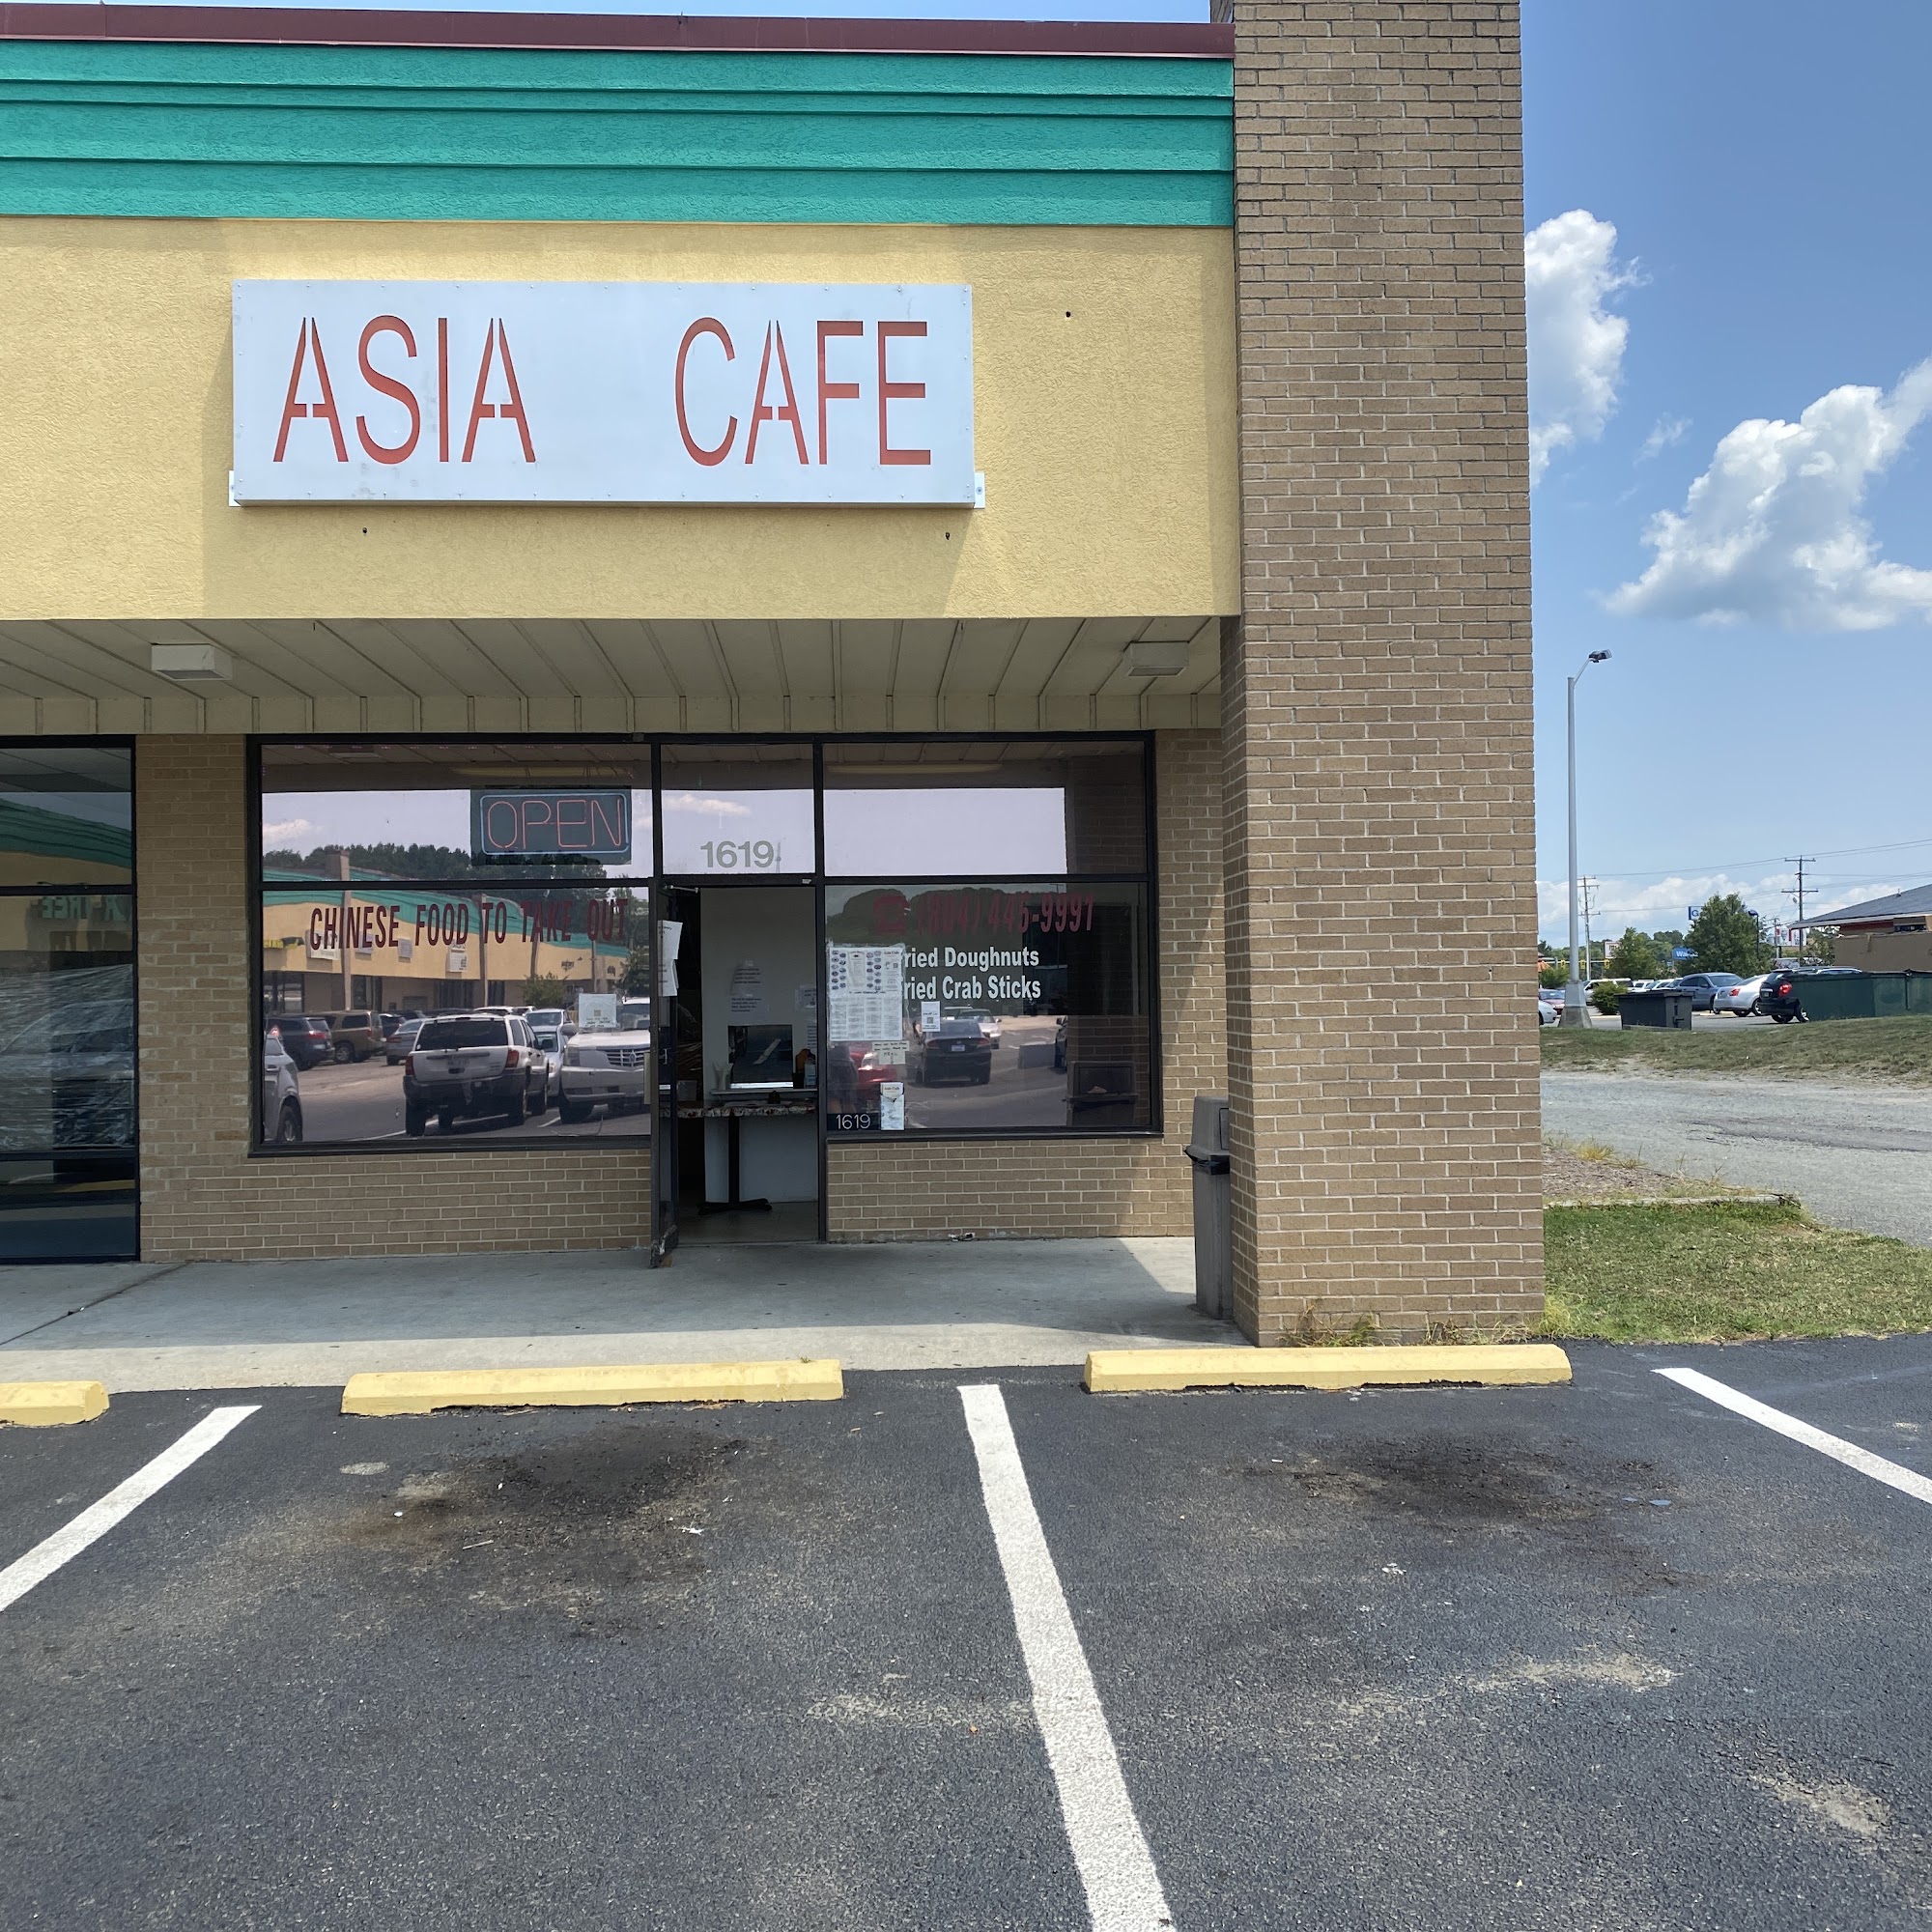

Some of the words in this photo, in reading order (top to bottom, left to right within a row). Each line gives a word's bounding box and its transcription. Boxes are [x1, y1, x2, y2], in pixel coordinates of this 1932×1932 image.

[272, 315, 536, 464] ASIA
[675, 317, 932, 466] CAFE
[487, 799, 622, 849] OPEN
[700, 840, 775, 868] 1619
[309, 904, 401, 951] CHINESE
[414, 902, 469, 947] FOOD
[480, 901, 507, 945] TO
[520, 899, 573, 943] TAKE
[586, 897, 628, 942] OUT
[904, 947, 938, 967] ried
[944, 947, 1039, 972] Doughnuts
[903, 976, 937, 1000] ried
[942, 975, 982, 1000] Crab
[987, 975, 1041, 1000] Sticks
[836, 1114, 871, 1129] 1619
